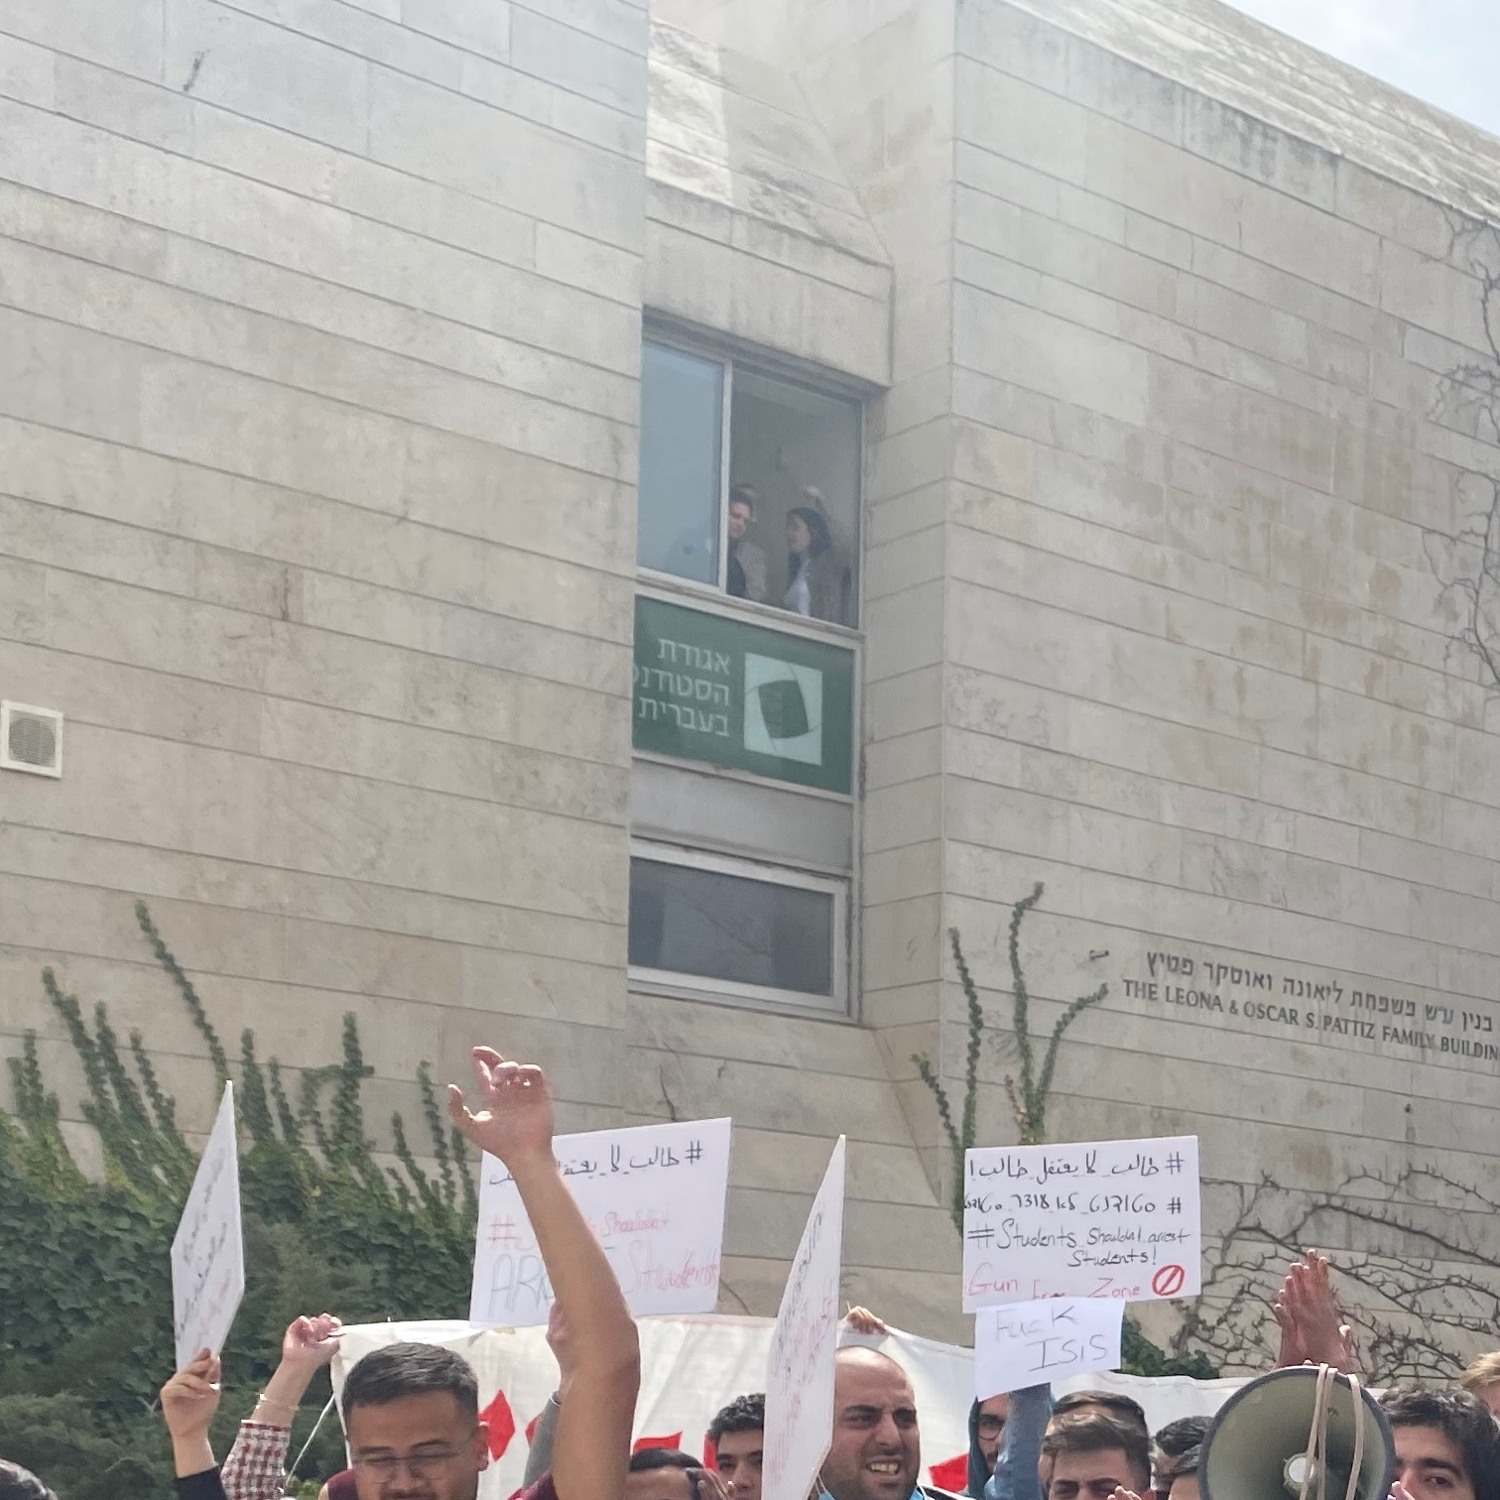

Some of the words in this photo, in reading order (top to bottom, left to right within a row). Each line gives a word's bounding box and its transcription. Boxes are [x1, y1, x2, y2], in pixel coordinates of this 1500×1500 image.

[657, 638, 731, 677] אגודת
[638, 697, 730, 737] בעברית
[1147, 951, 1195, 977] פטיץ
[1203, 961, 1273, 990] ואוסקר
[1283, 977, 1343, 1004] ליאונה
[1122, 979, 1158, 1001] THE
[1165, 985, 1225, 1013] LEONA
[1229, 1001, 1239, 1015] &
[1243, 1001, 1300, 1026] OSCAR
[1323, 1015, 1376, 1040] PATTIZ
[1382, 1025, 1436, 1051] FAMILY
[1462, 1011, 1493, 1032] בנין
